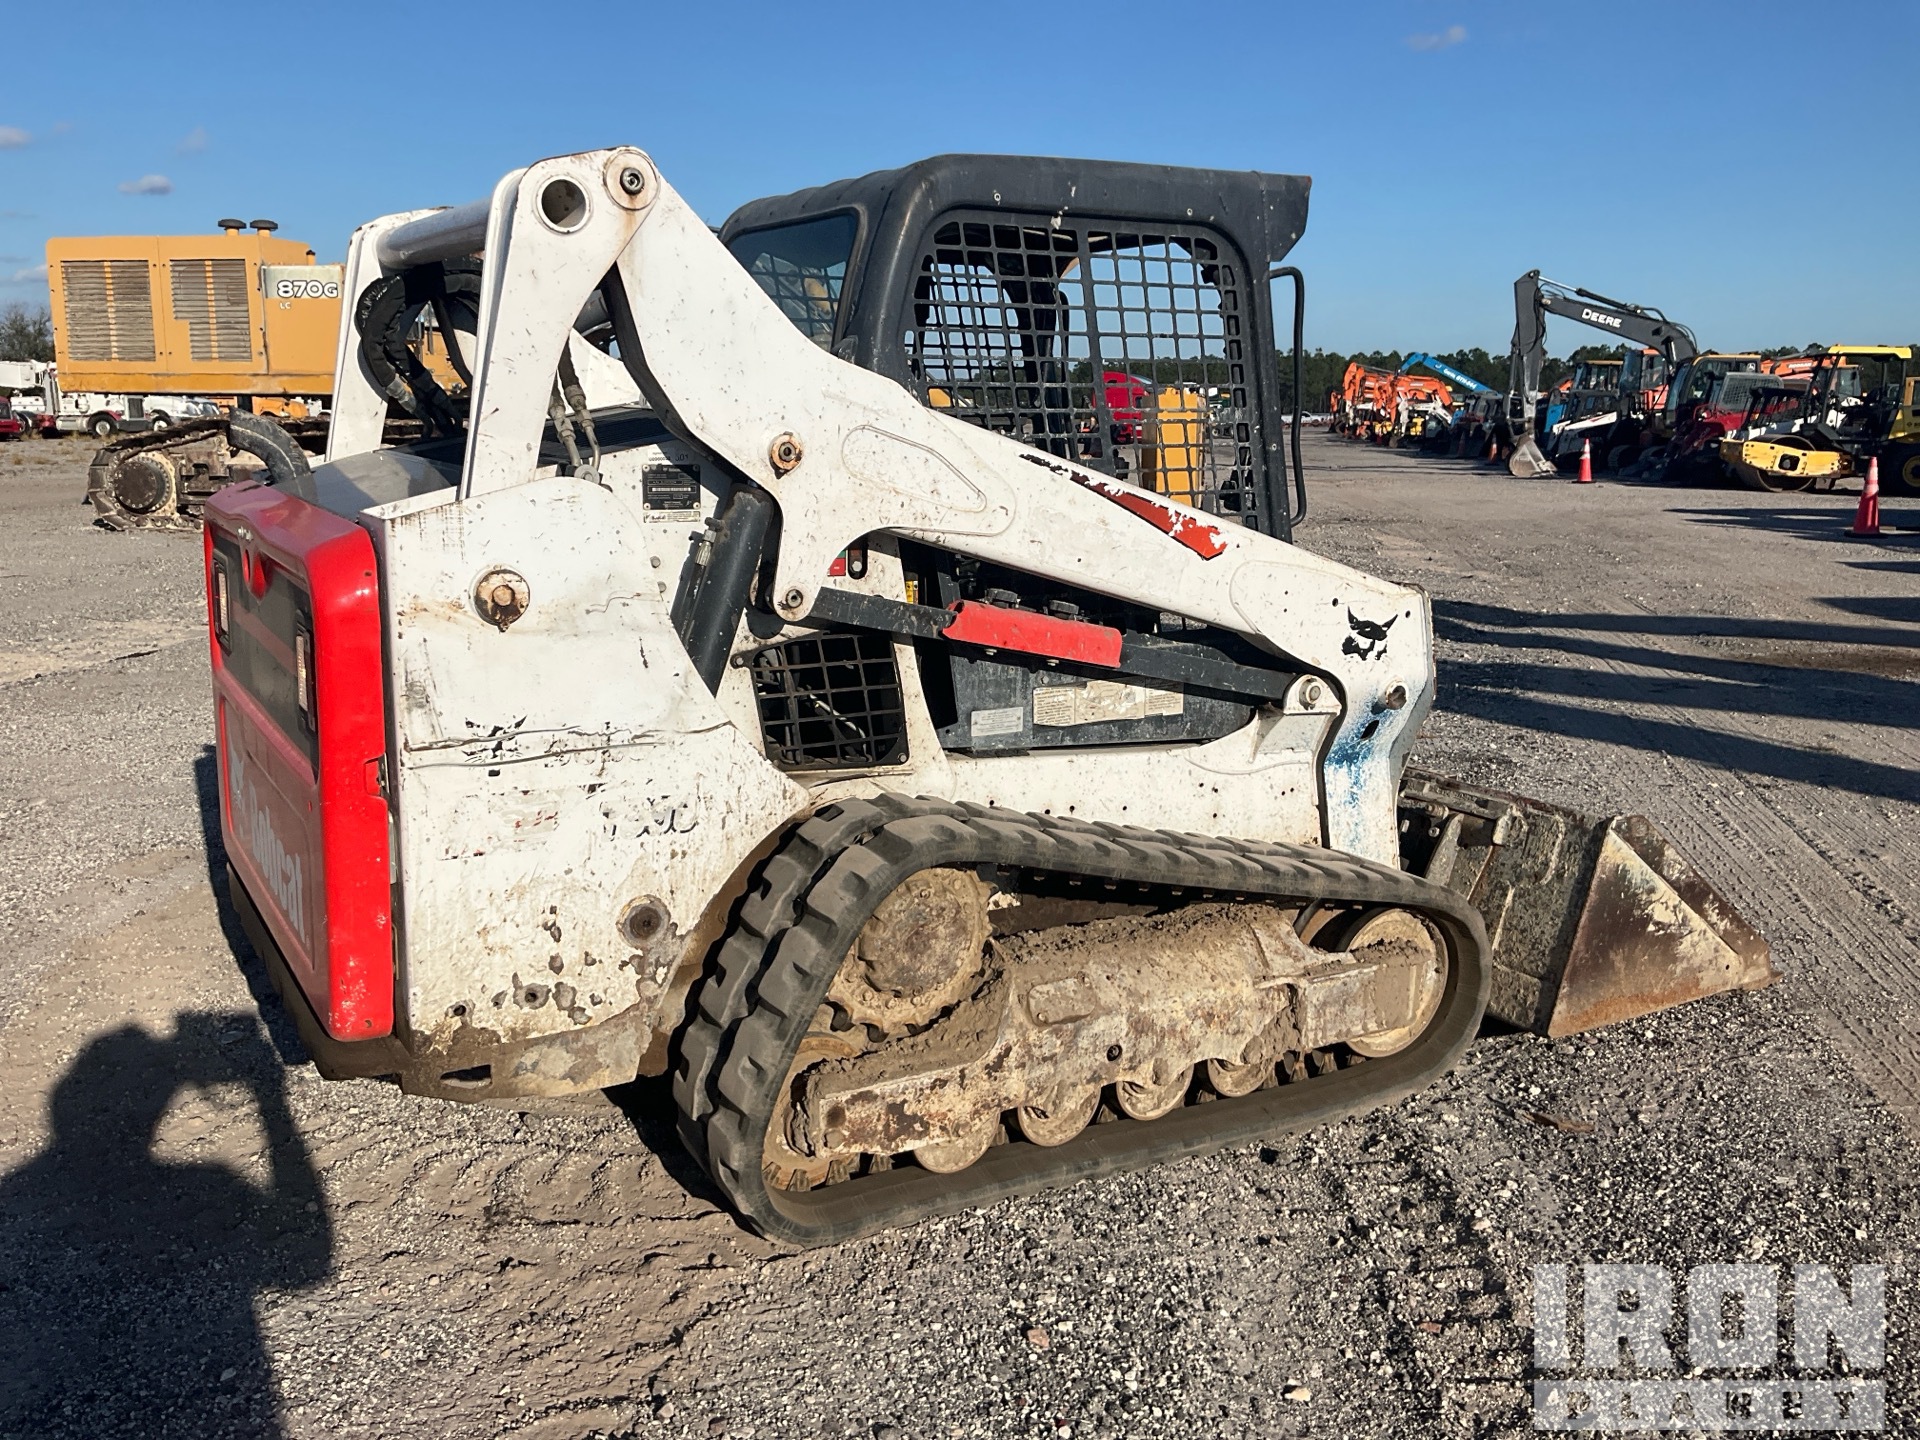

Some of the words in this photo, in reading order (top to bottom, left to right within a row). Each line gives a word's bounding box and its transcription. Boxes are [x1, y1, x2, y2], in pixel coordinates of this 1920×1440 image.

[277, 280, 338, 298] 870G
[1581, 308, 1622, 328] DEERE
[249, 778, 306, 944] Bobcat
